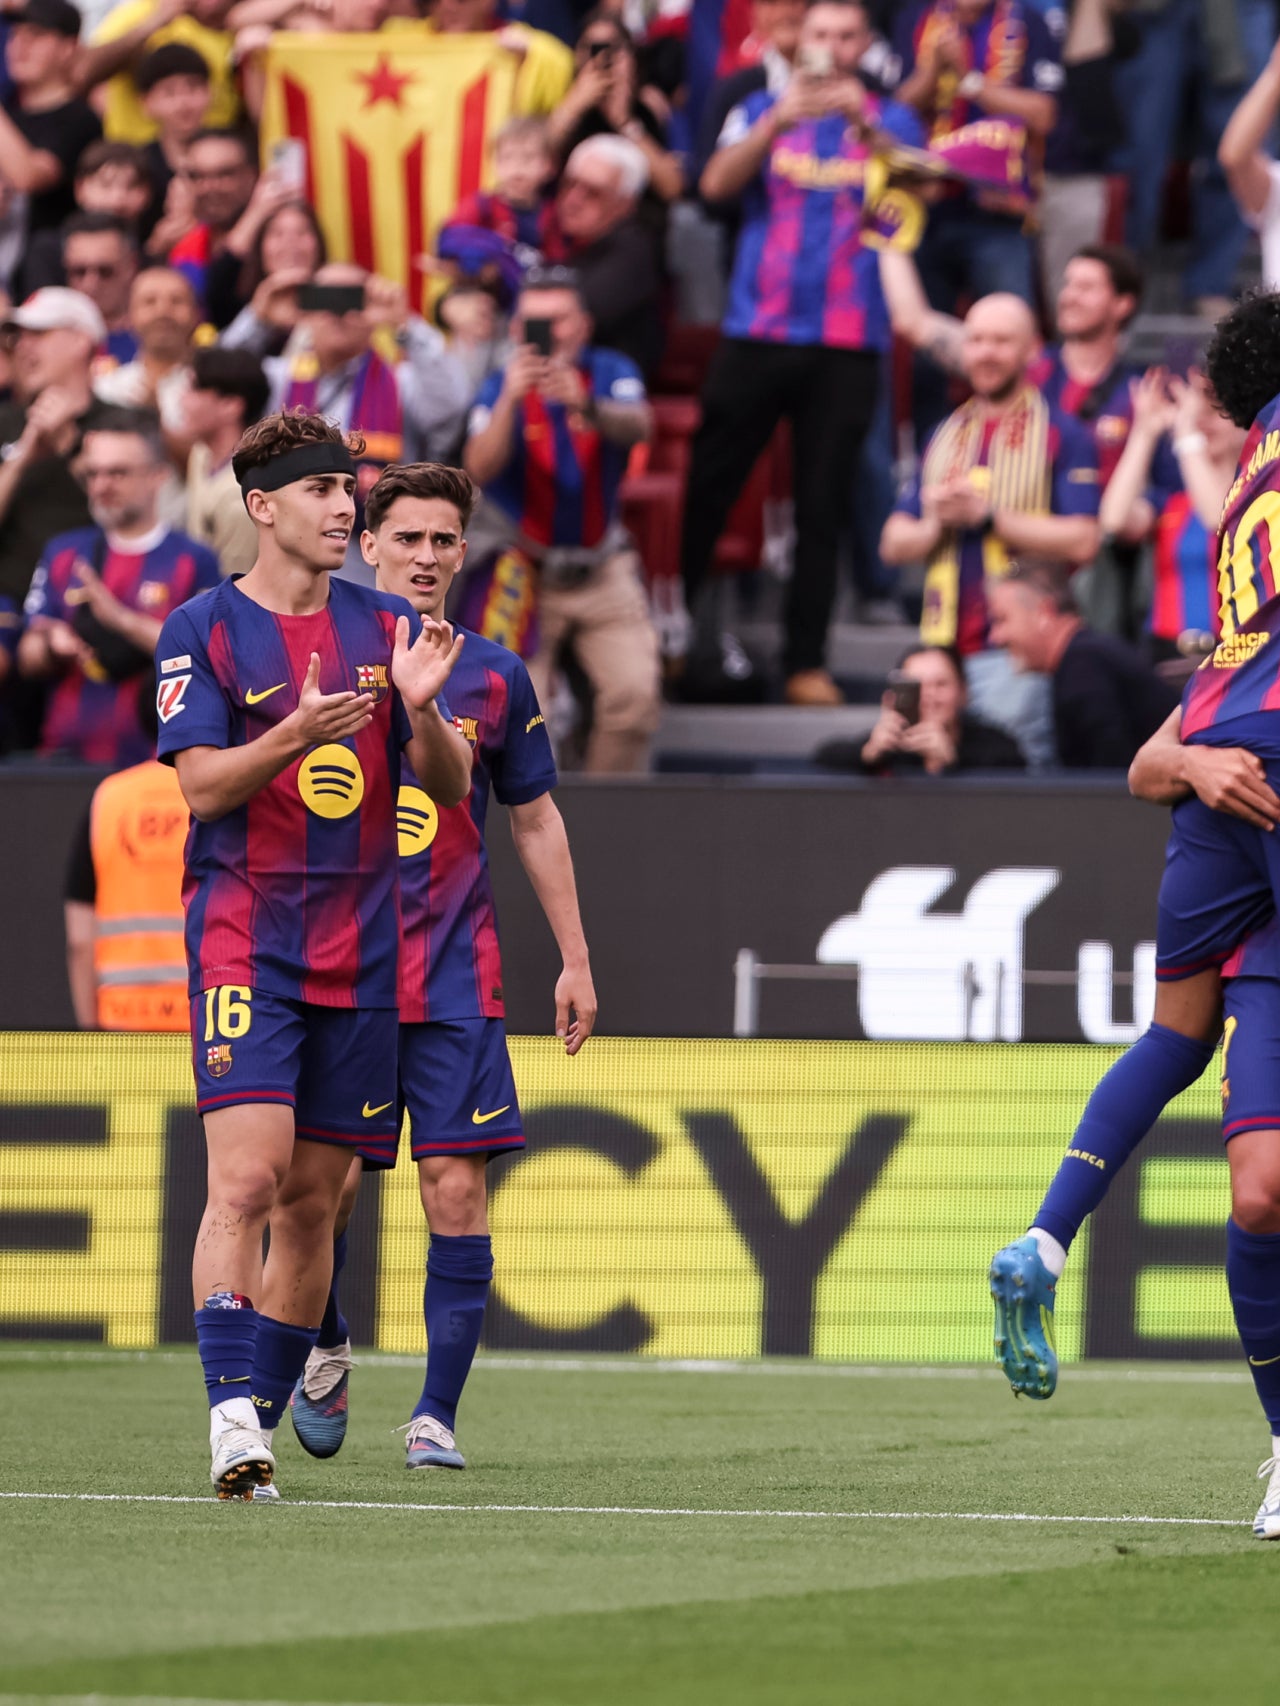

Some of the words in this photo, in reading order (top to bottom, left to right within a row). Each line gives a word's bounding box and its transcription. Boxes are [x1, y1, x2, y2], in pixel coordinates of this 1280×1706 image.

[1217, 632, 1270, 648] NHCR
[1212, 646, 1259, 663] ACNU
[203, 984, 252, 1042] 16
